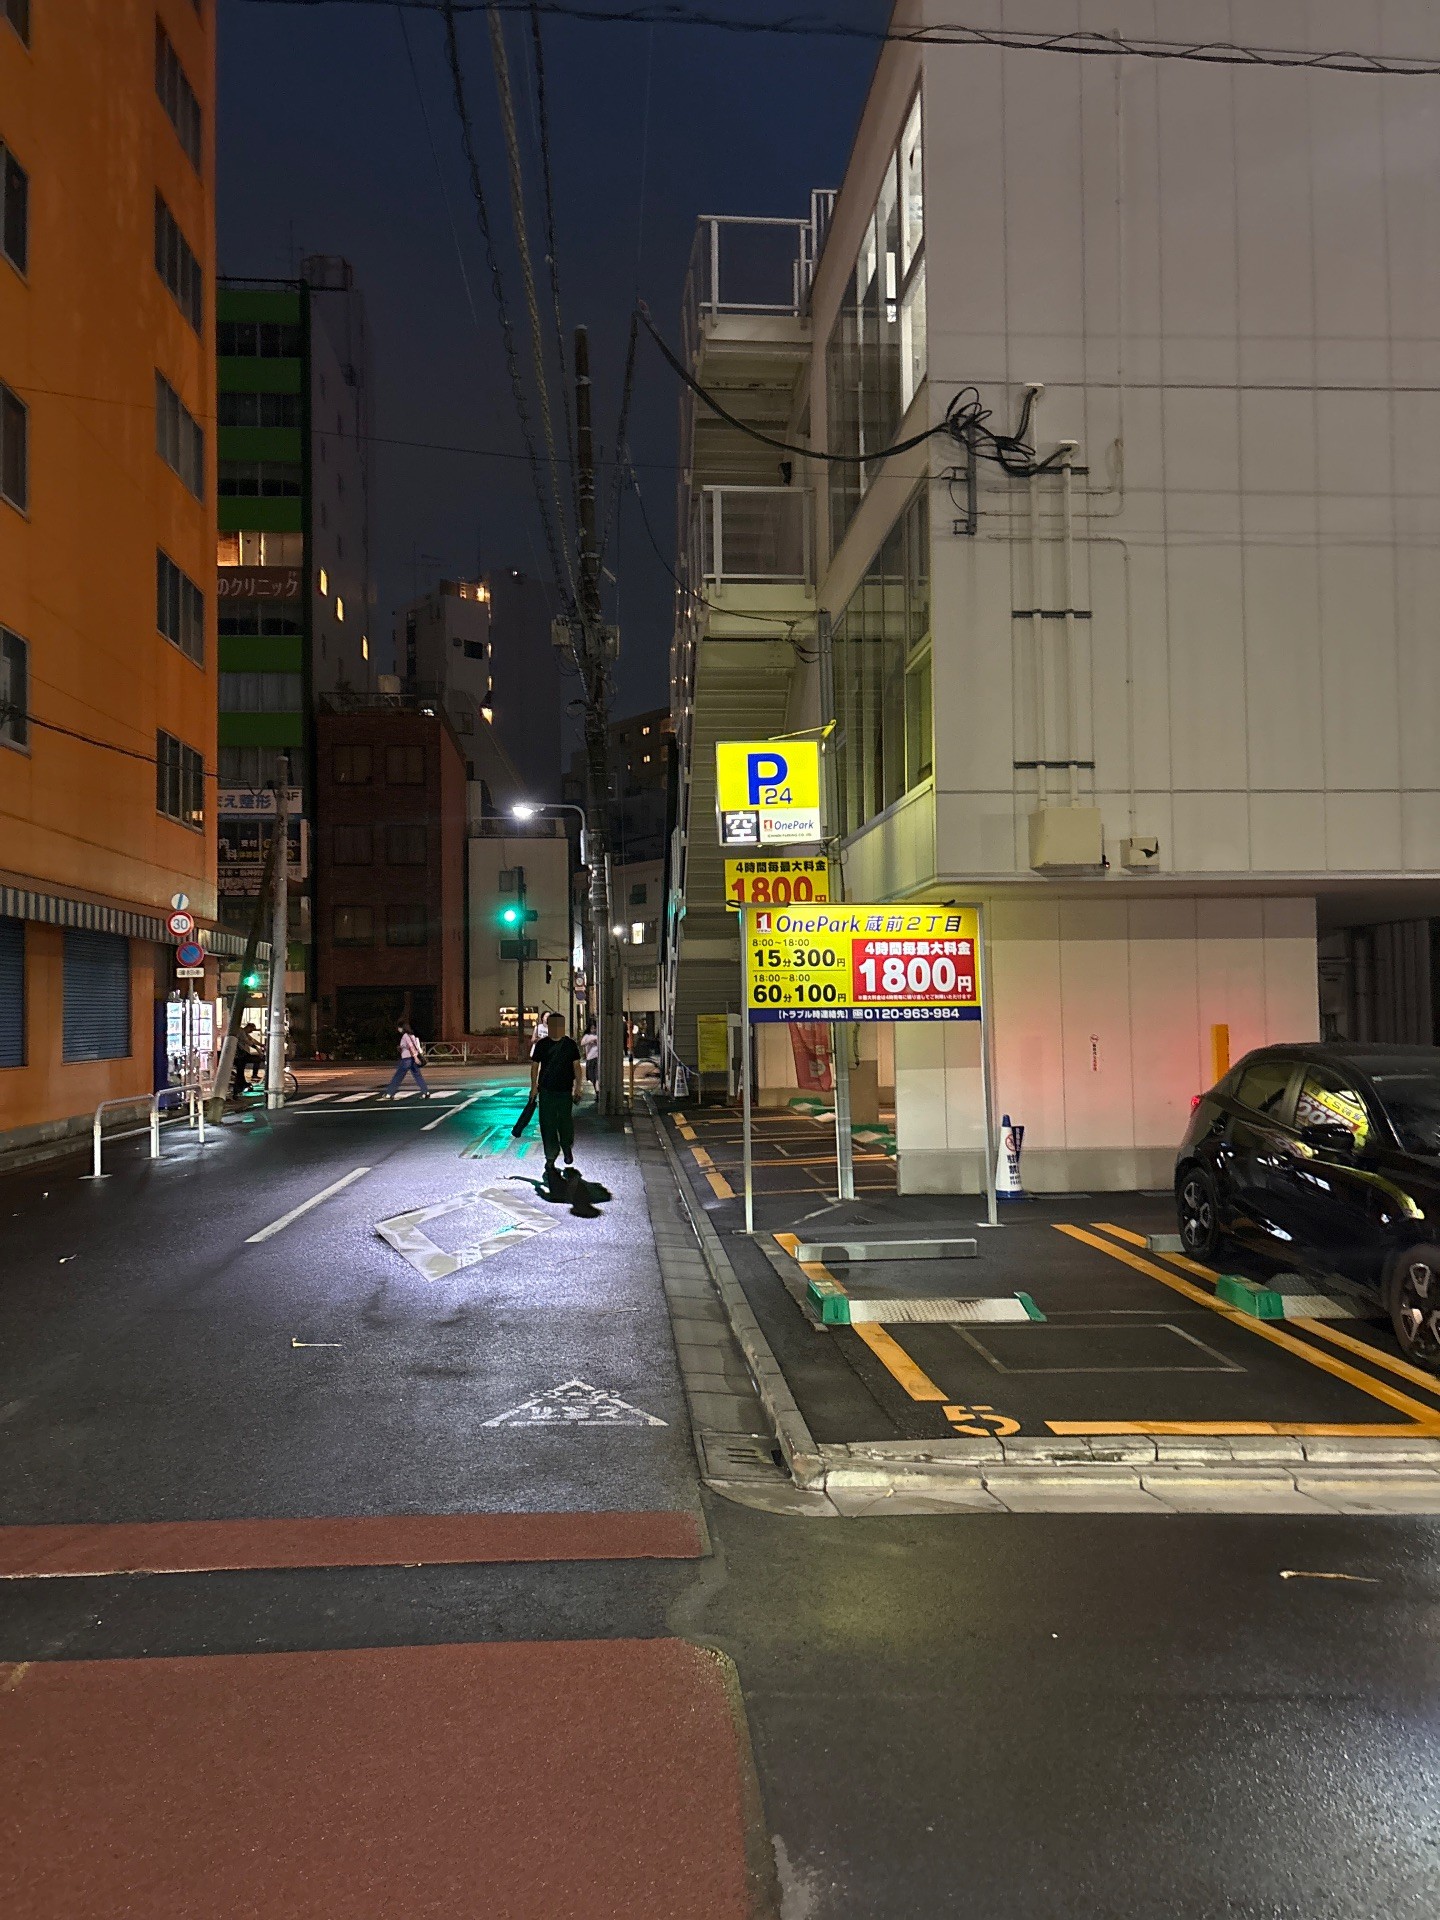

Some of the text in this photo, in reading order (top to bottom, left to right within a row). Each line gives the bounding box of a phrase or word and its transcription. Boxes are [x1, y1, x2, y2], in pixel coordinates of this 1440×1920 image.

[747, 753, 788, 805] P
[765, 787, 793, 805] 24
[725, 811, 758, 842] 空
[774, 820, 814, 831] OnePark
[736, 860, 826, 873] 4時間毎最大料金
[173, 918, 188, 930] 30
[776, 914, 860, 933] OnePark
[864, 915, 962, 933] 蔵前2丁目
[864, 941, 971, 956] 4時間毎最大料金
[858, 957, 973, 993] 1800円
[864, 1008, 960, 1019] 0120-963-984
[941, 1405, 1021, 1436] 5
